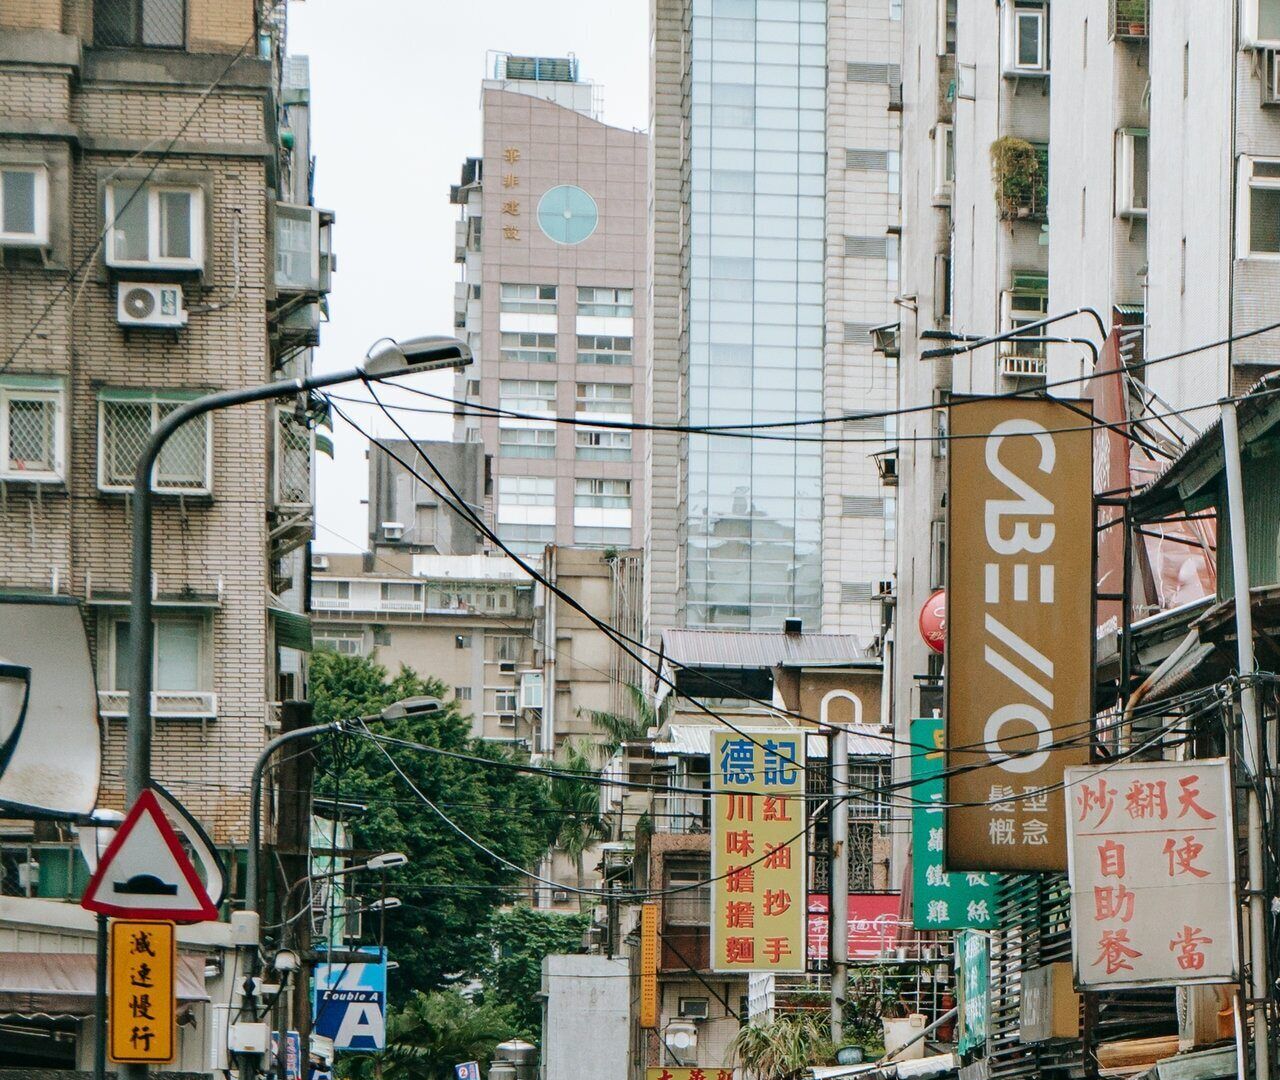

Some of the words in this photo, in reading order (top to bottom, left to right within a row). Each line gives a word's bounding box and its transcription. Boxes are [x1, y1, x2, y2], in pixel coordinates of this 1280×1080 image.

[720, 739, 799, 786] 德記
[988, 784, 1048, 813] 髮型
[1076, 776, 1217, 831] 炒翻天
[762, 794, 792, 964] 紅油抄手
[1161, 837, 1212, 971] 便當
[1091, 838, 1144, 977] 自助餐
[129, 930, 155, 1052] 減速慢行
[369, 991, 379, 1001] A
[333, 1002, 385, 1049] A
